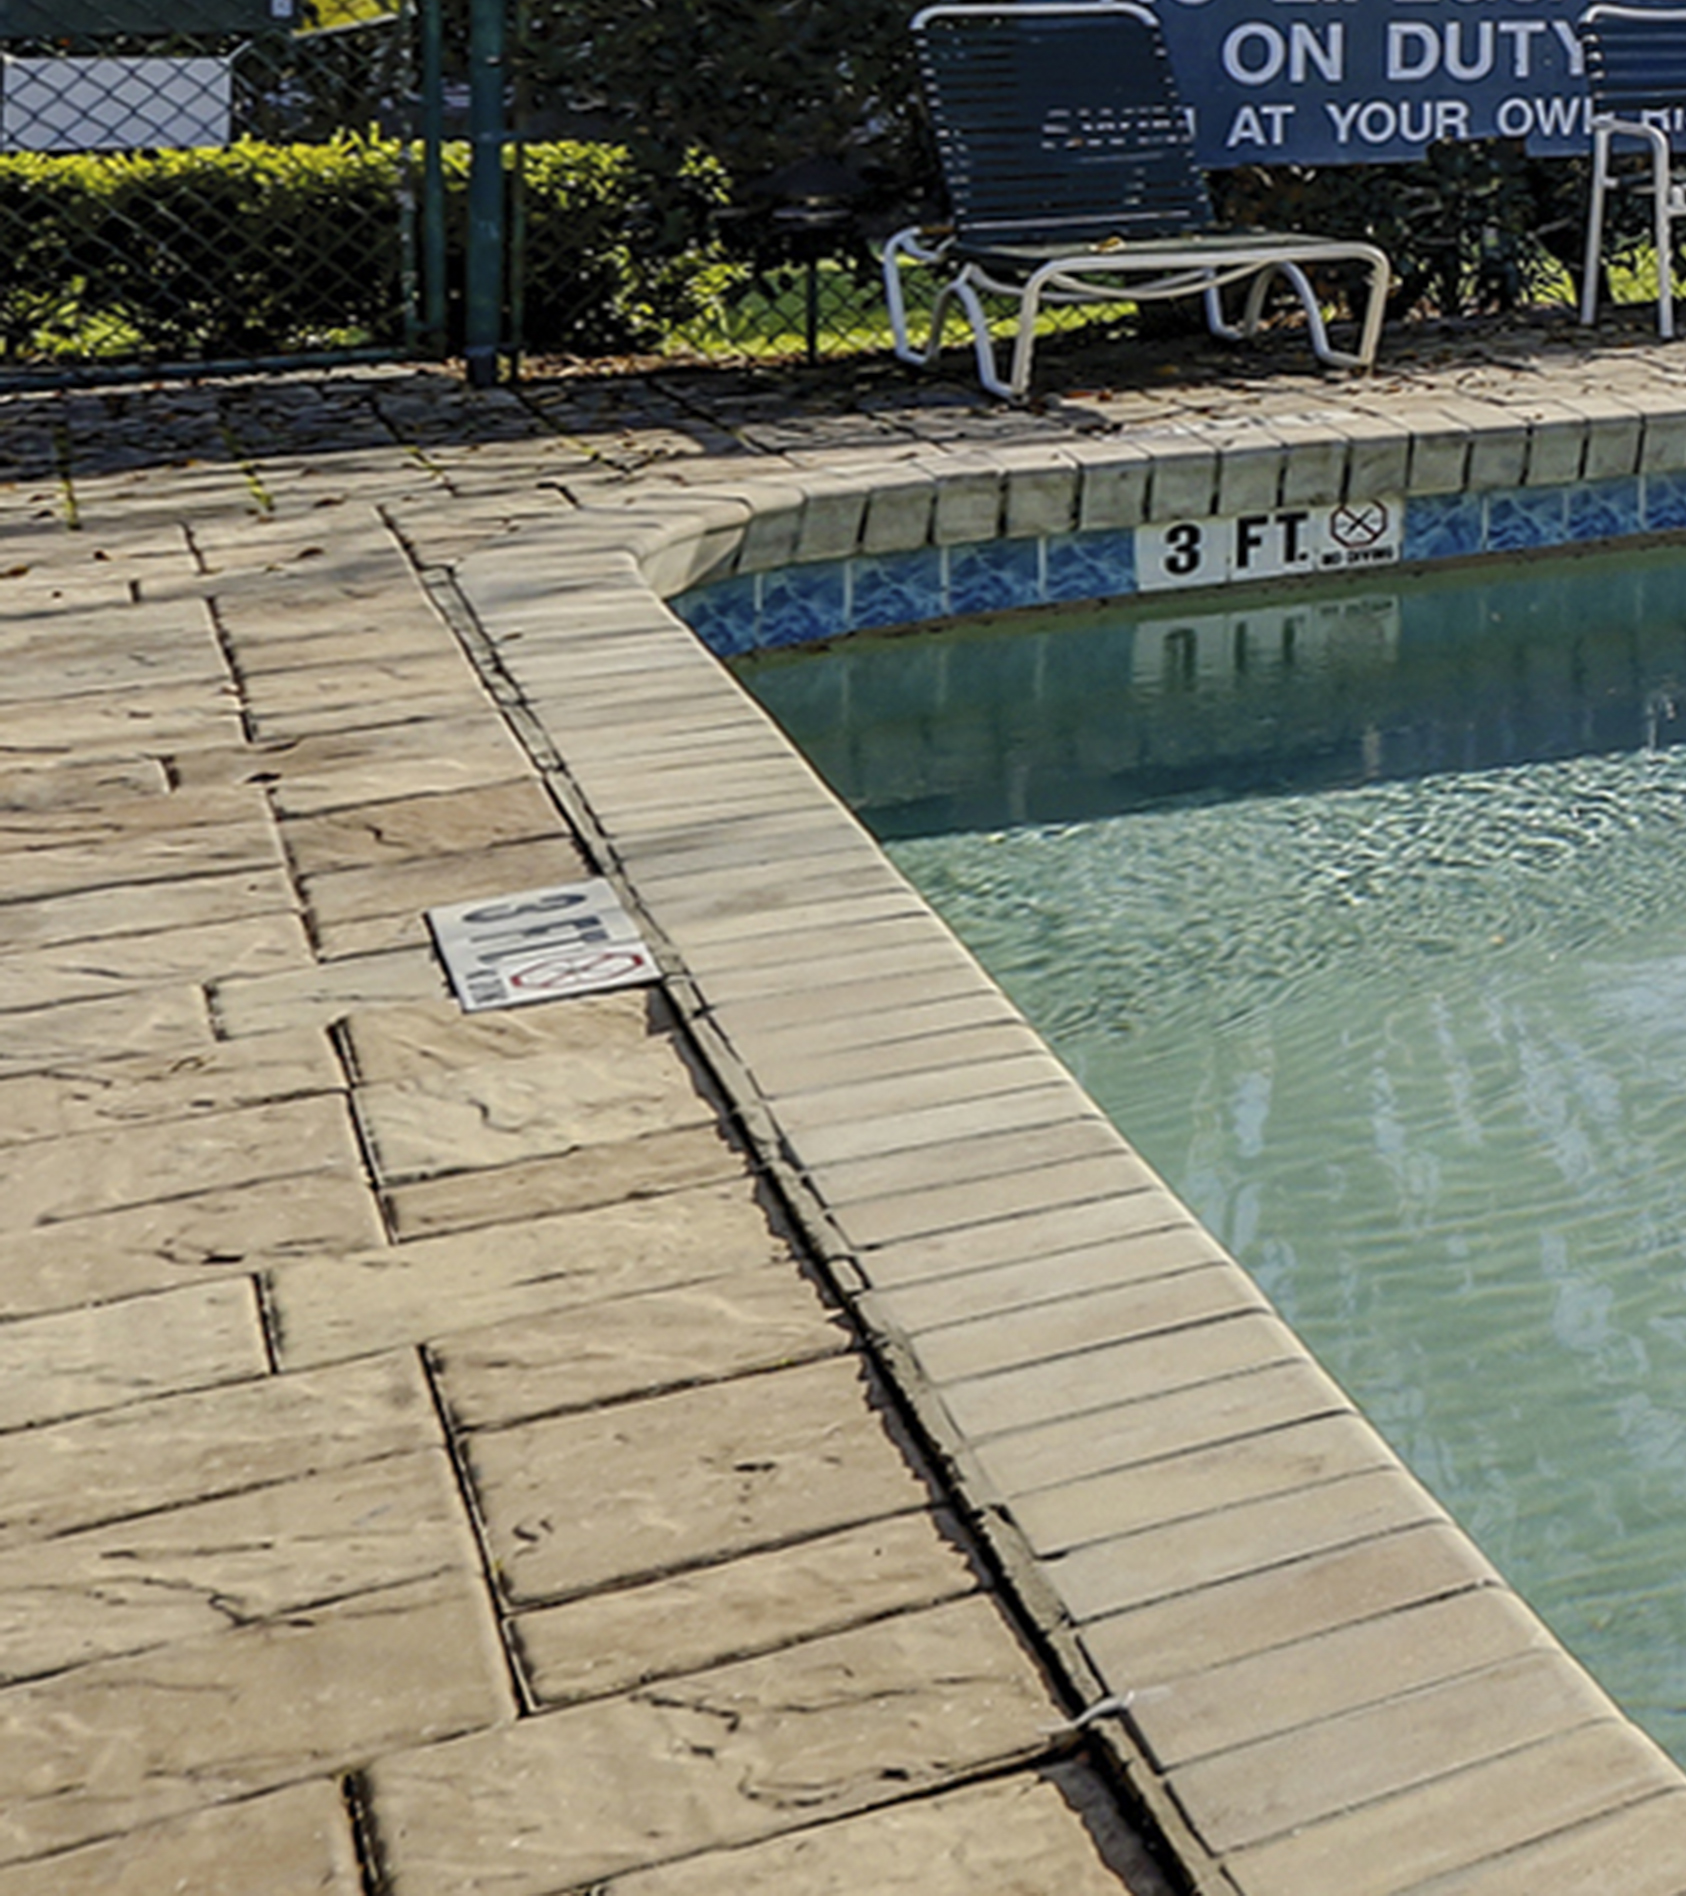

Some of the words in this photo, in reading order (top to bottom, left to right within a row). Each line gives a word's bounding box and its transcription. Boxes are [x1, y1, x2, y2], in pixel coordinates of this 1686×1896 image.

[1222, 21, 1343, 85] ON
[1225, 104, 1296, 147] AT
[1325, 100, 1469, 144] YOUR
[1164, 523, 1201, 575] 3
[1235, 511, 1308, 568] FT.
